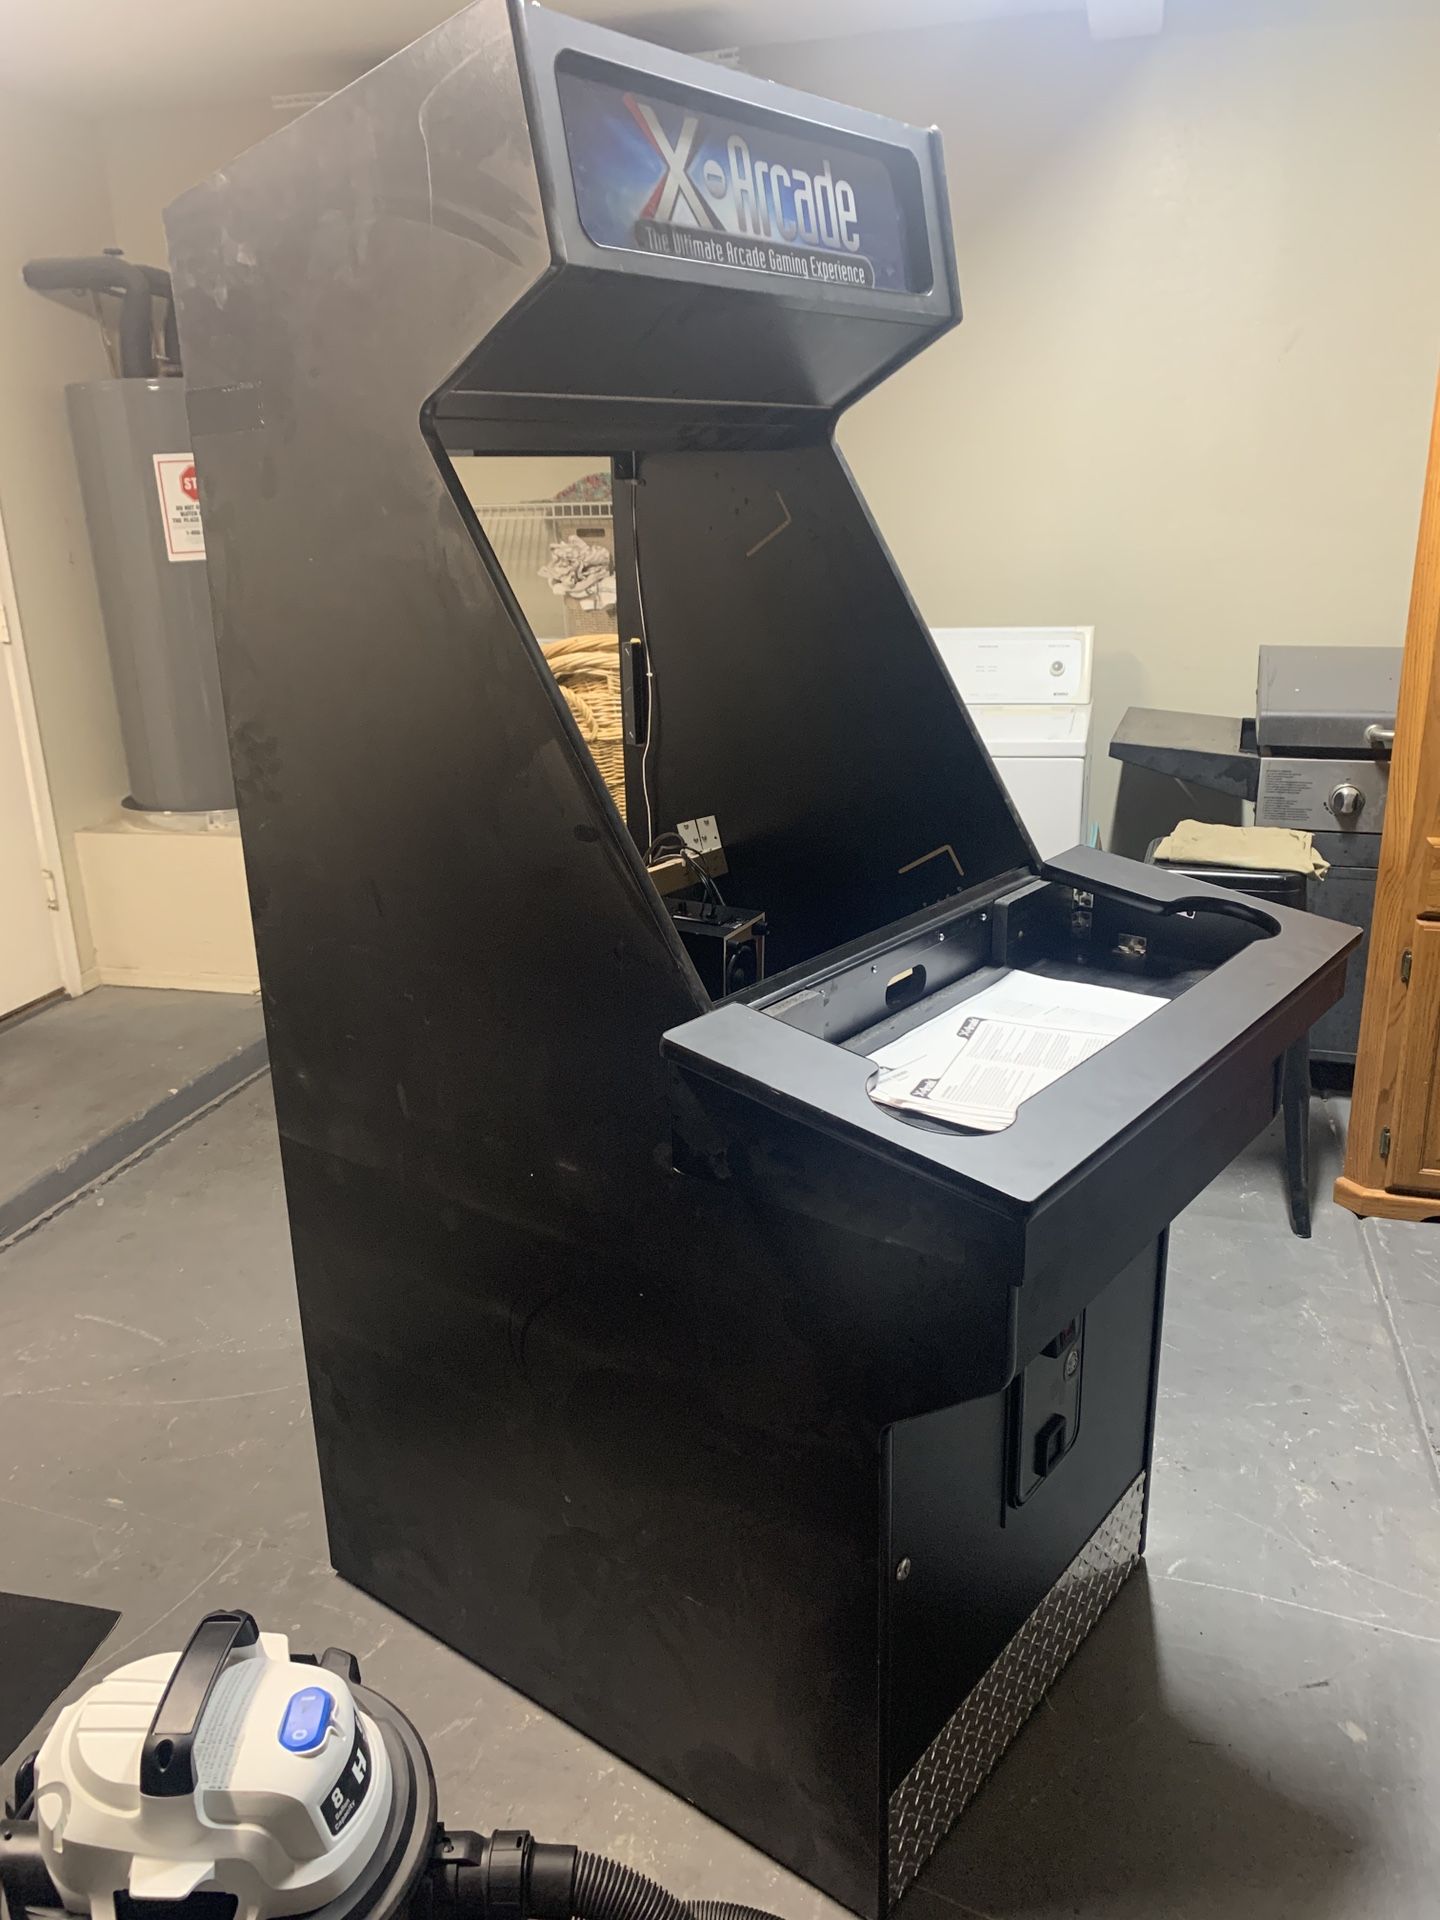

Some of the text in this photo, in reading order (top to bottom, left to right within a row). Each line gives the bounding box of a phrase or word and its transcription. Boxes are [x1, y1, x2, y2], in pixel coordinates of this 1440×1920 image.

[645, 226, 866, 285] The Ultimate Arcade Gaming Experience
[183, 476, 197, 490] ST
[331, 1786, 344, 1809] 8
[334, 1798, 351, 1821] Gallon
[334, 1800, 356, 1831] Capacity
